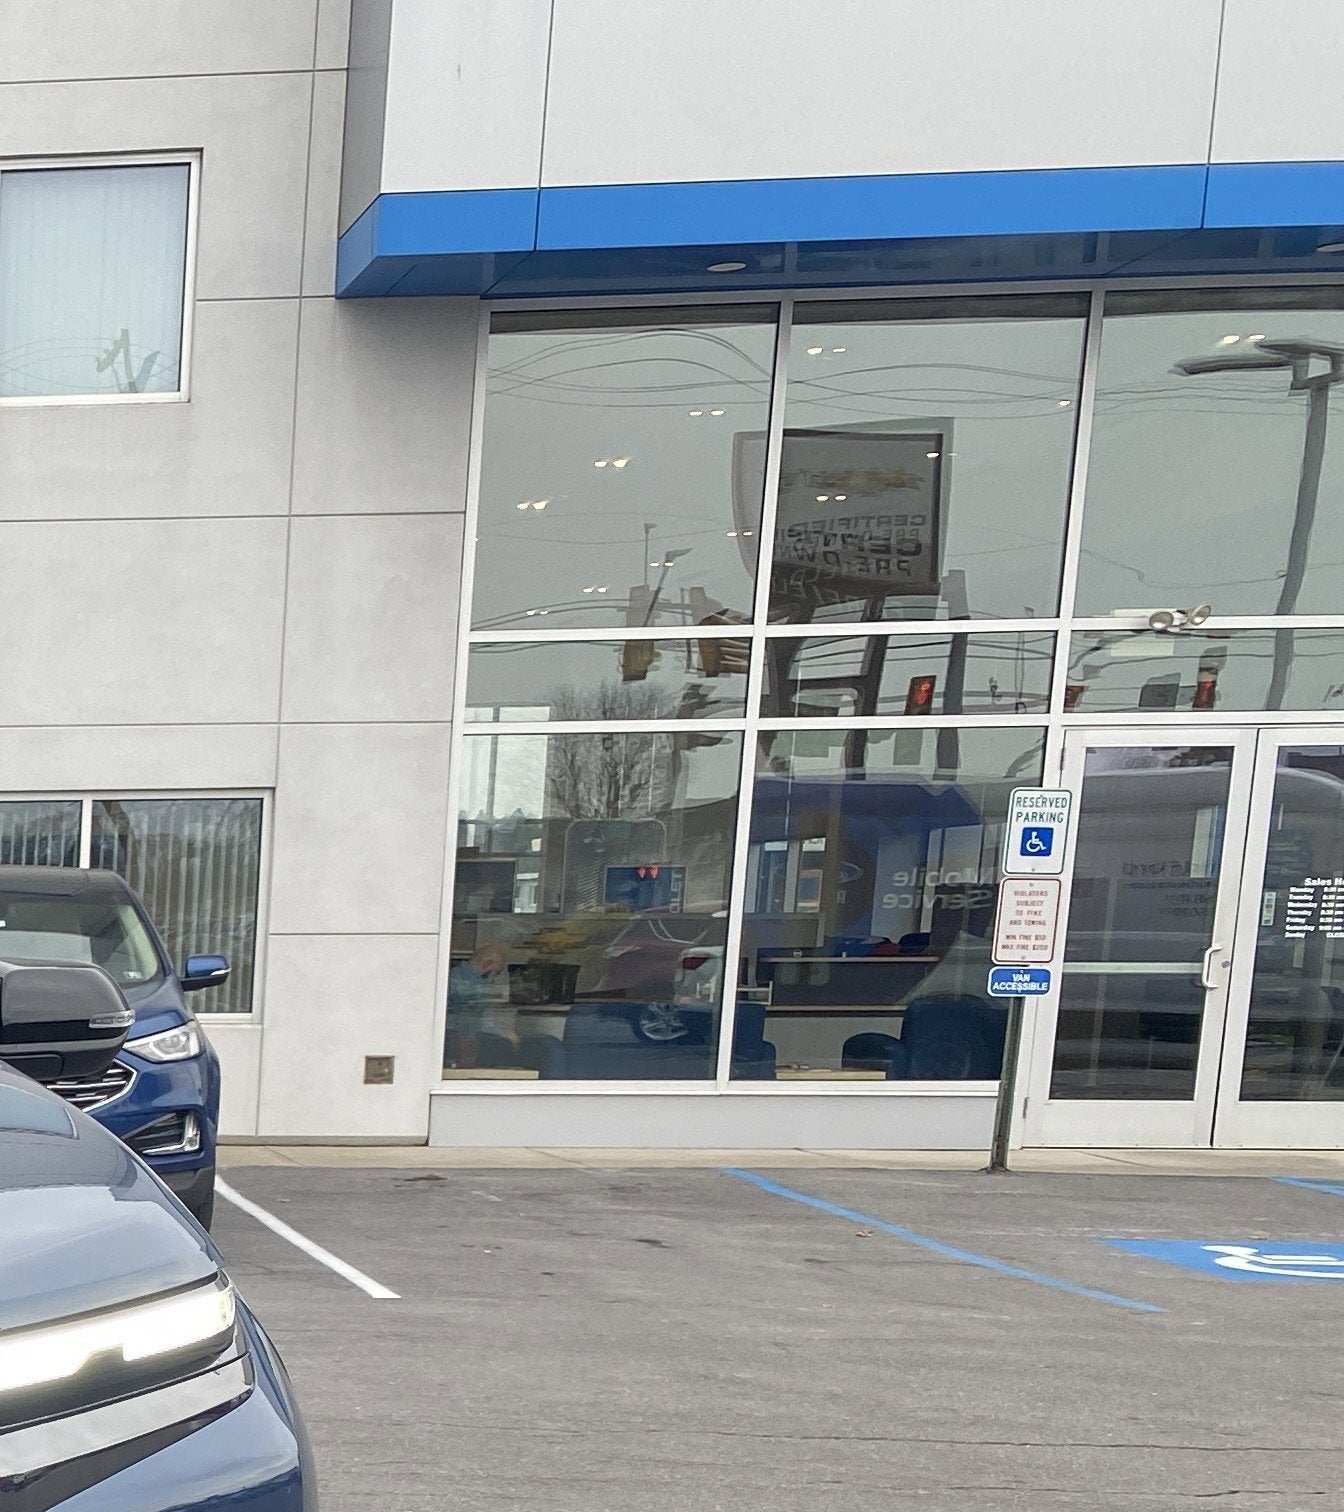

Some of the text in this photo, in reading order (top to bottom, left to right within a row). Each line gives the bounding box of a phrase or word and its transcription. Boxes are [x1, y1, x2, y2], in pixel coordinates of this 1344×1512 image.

[1016, 796, 1068, 808] RESERVED
[1016, 811, 1065, 823] PARKING
[1305, 878, 1332, 886] Sales
[992, 982, 1048, 991] ACCESSIBLE
